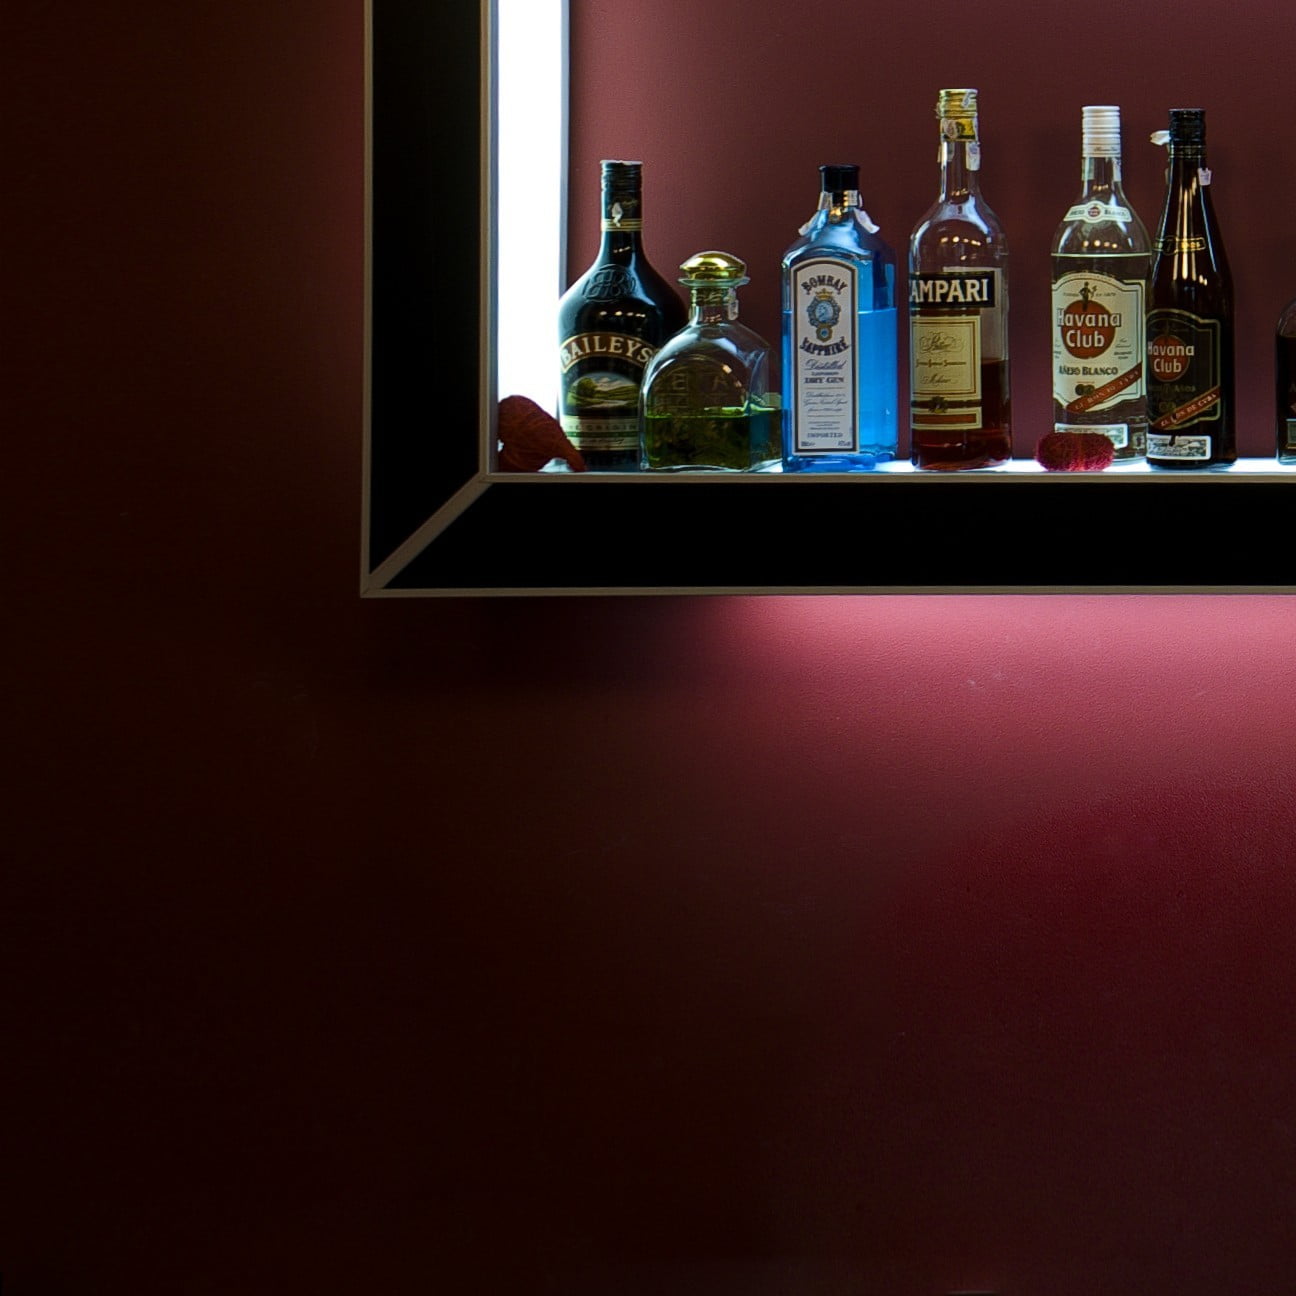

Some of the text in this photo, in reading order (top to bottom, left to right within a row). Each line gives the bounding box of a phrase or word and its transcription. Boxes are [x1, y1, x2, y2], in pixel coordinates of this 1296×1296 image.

[800, 274, 849, 296] BOMBAY
[910, 278, 990, 303] AMPARI
[1057, 307, 1122, 328] Havana
[799, 335, 850, 356] SAPPHIRE
[1066, 330, 1105, 348] Club
[1147, 341, 1196, 357] Havana
[559, 335, 654, 369] BAILEYS
[1082, 366, 1118, 376] BLANCO
[1153, 358, 1182, 373] Club
